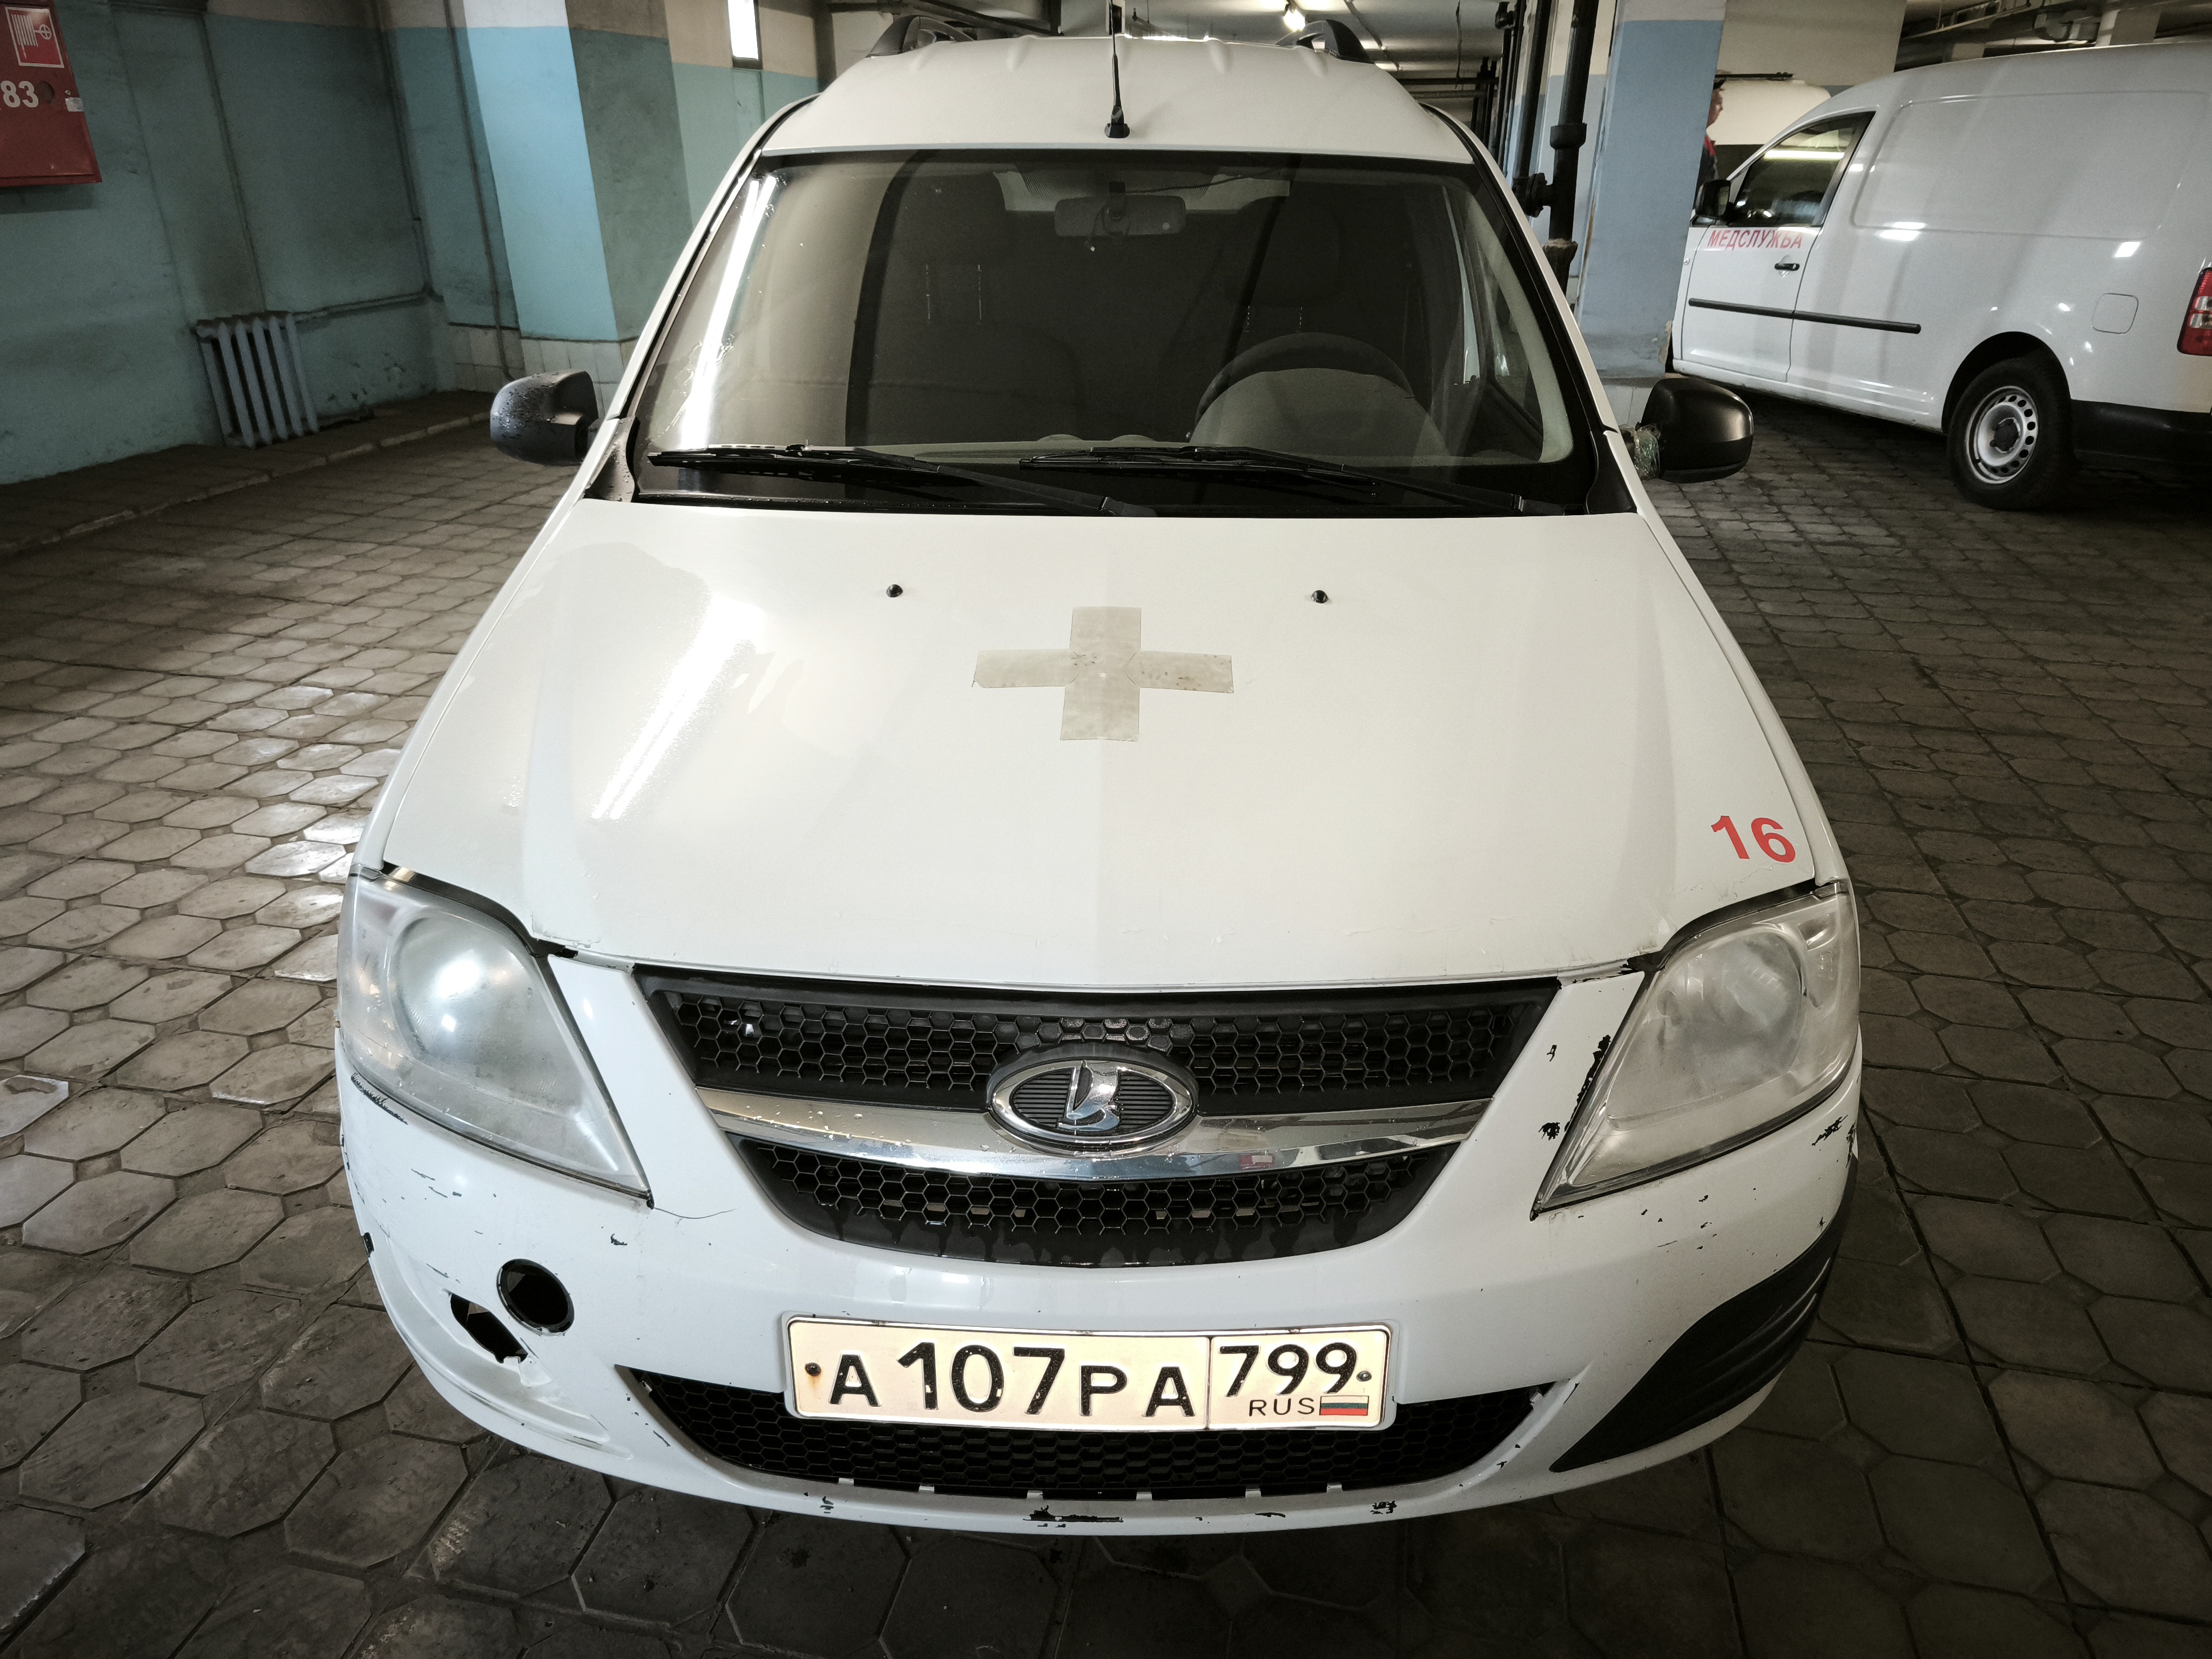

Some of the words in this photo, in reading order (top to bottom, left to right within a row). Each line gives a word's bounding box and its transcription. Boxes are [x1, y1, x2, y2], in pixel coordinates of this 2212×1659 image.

[1, 80, 39, 107] 83
[1707, 230, 1804, 251] МЕДСЛУЖБА
[1711, 815, 1796, 863] 16
[1218, 1342, 1357, 1398] 799
[1249, 1397, 1315, 1417] RUS
